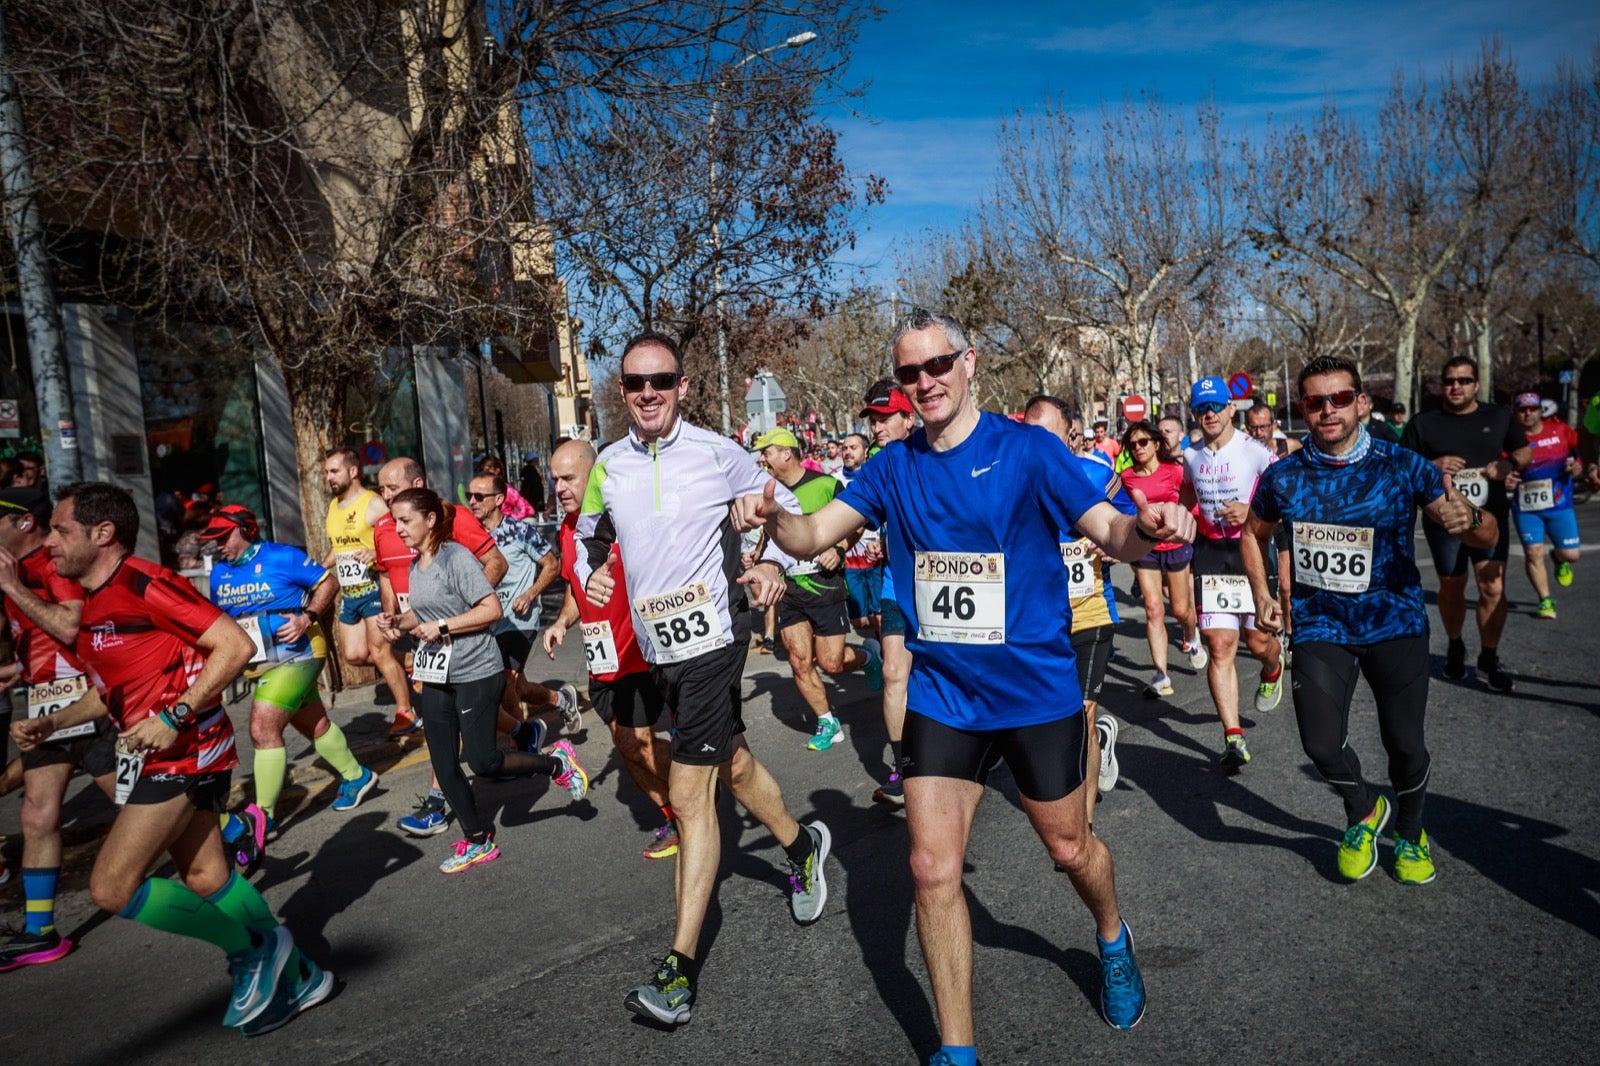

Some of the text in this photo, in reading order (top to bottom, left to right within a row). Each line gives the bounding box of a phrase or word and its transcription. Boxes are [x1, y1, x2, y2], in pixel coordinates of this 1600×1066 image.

[1523, 491, 1549, 504] 676
[1308, 529, 1357, 542] FONDO
[338, 563, 362, 578] 923
[929, 560, 983, 575] FONDO
[1298, 548, 1366, 577] 3036
[1065, 562, 1085, 584] 8
[650, 591, 695, 614] FONDO
[932, 585, 976, 621] 46
[1217, 592, 1242, 609] 65
[654, 610, 710, 648] 583
[416, 651, 446, 671] 3072
[36, 684, 73, 698] FONDO
